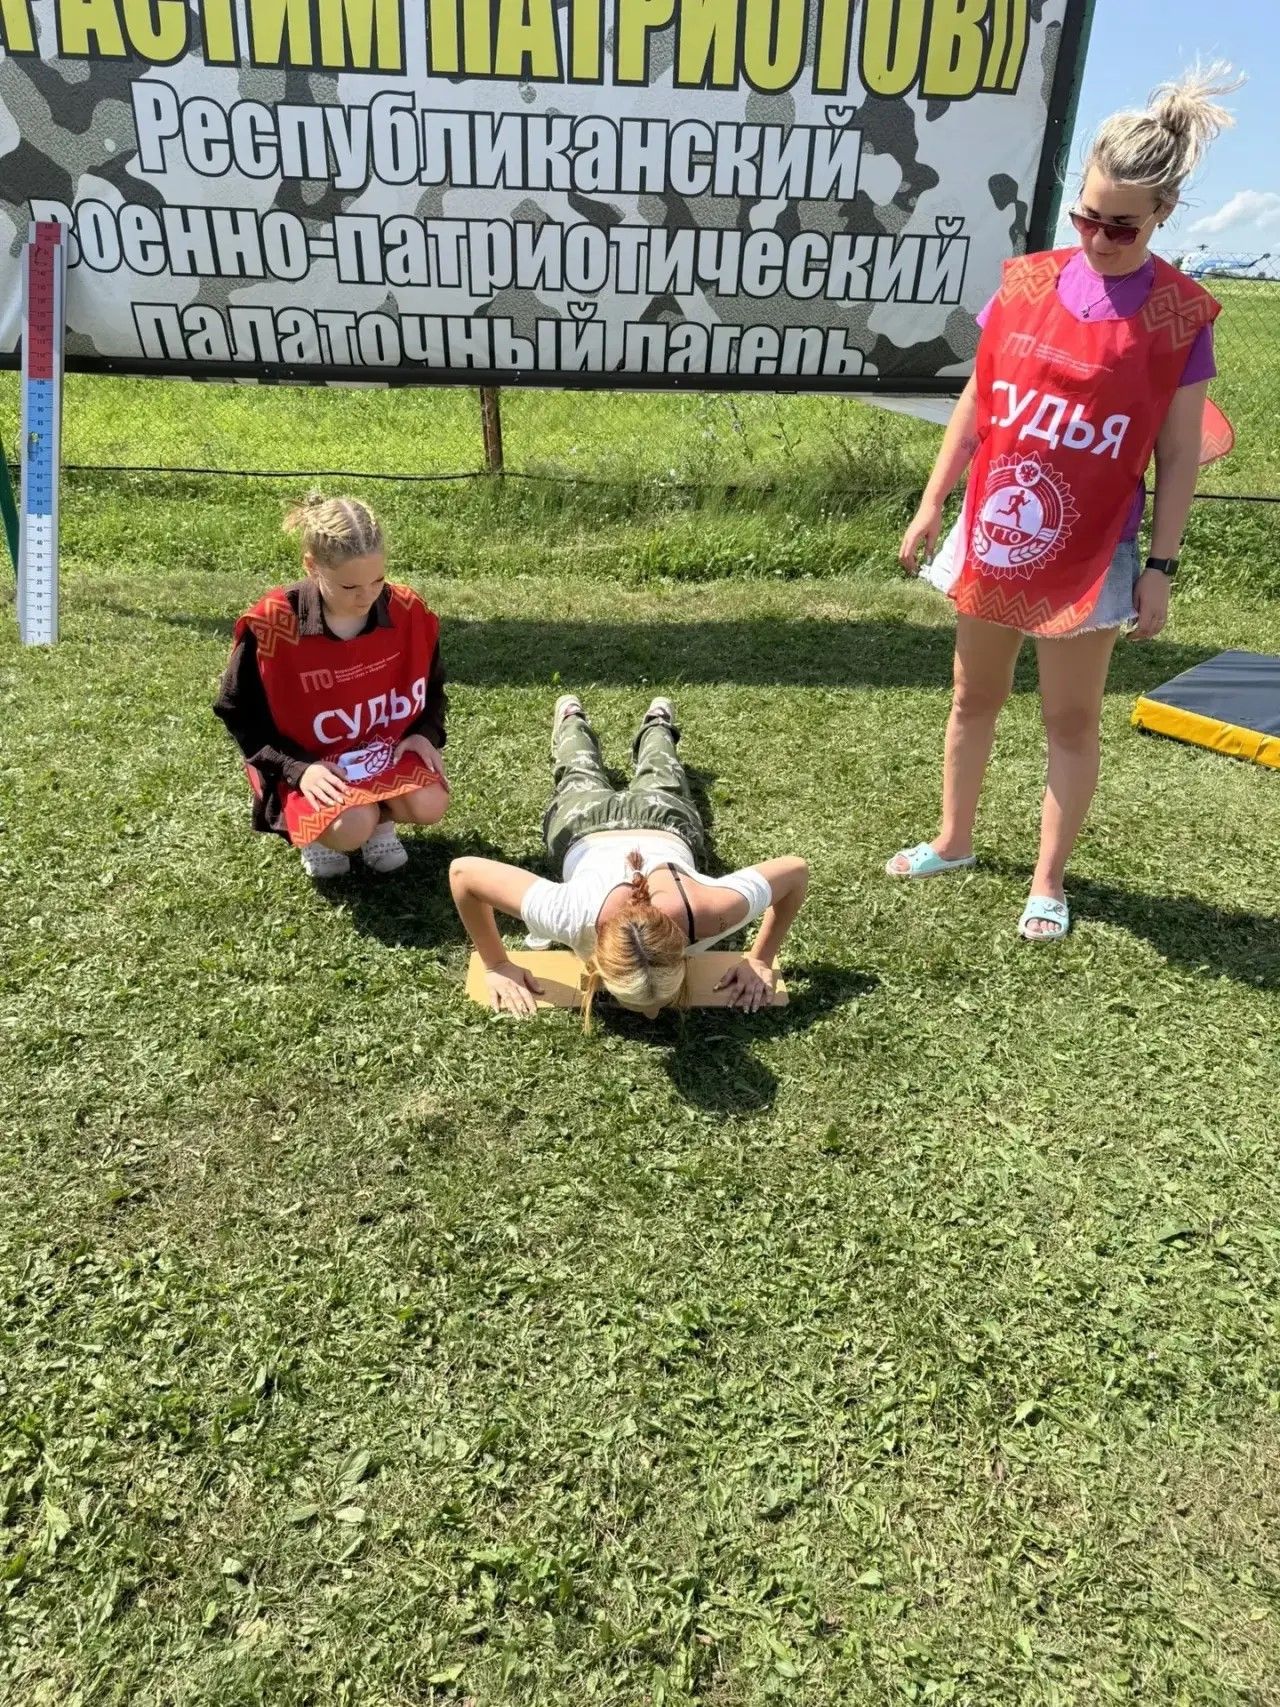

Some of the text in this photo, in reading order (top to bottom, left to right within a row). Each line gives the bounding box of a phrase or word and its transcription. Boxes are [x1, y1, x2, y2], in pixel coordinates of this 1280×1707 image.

[130, 78, 863, 201] Республиканский
[131, 301, 866, 376] палаточный лагерь
[990, 525, 1022, 544] ГТО
[299, 668, 334, 694] ГТО
[313, 676, 426, 745] СУДЬЯ
